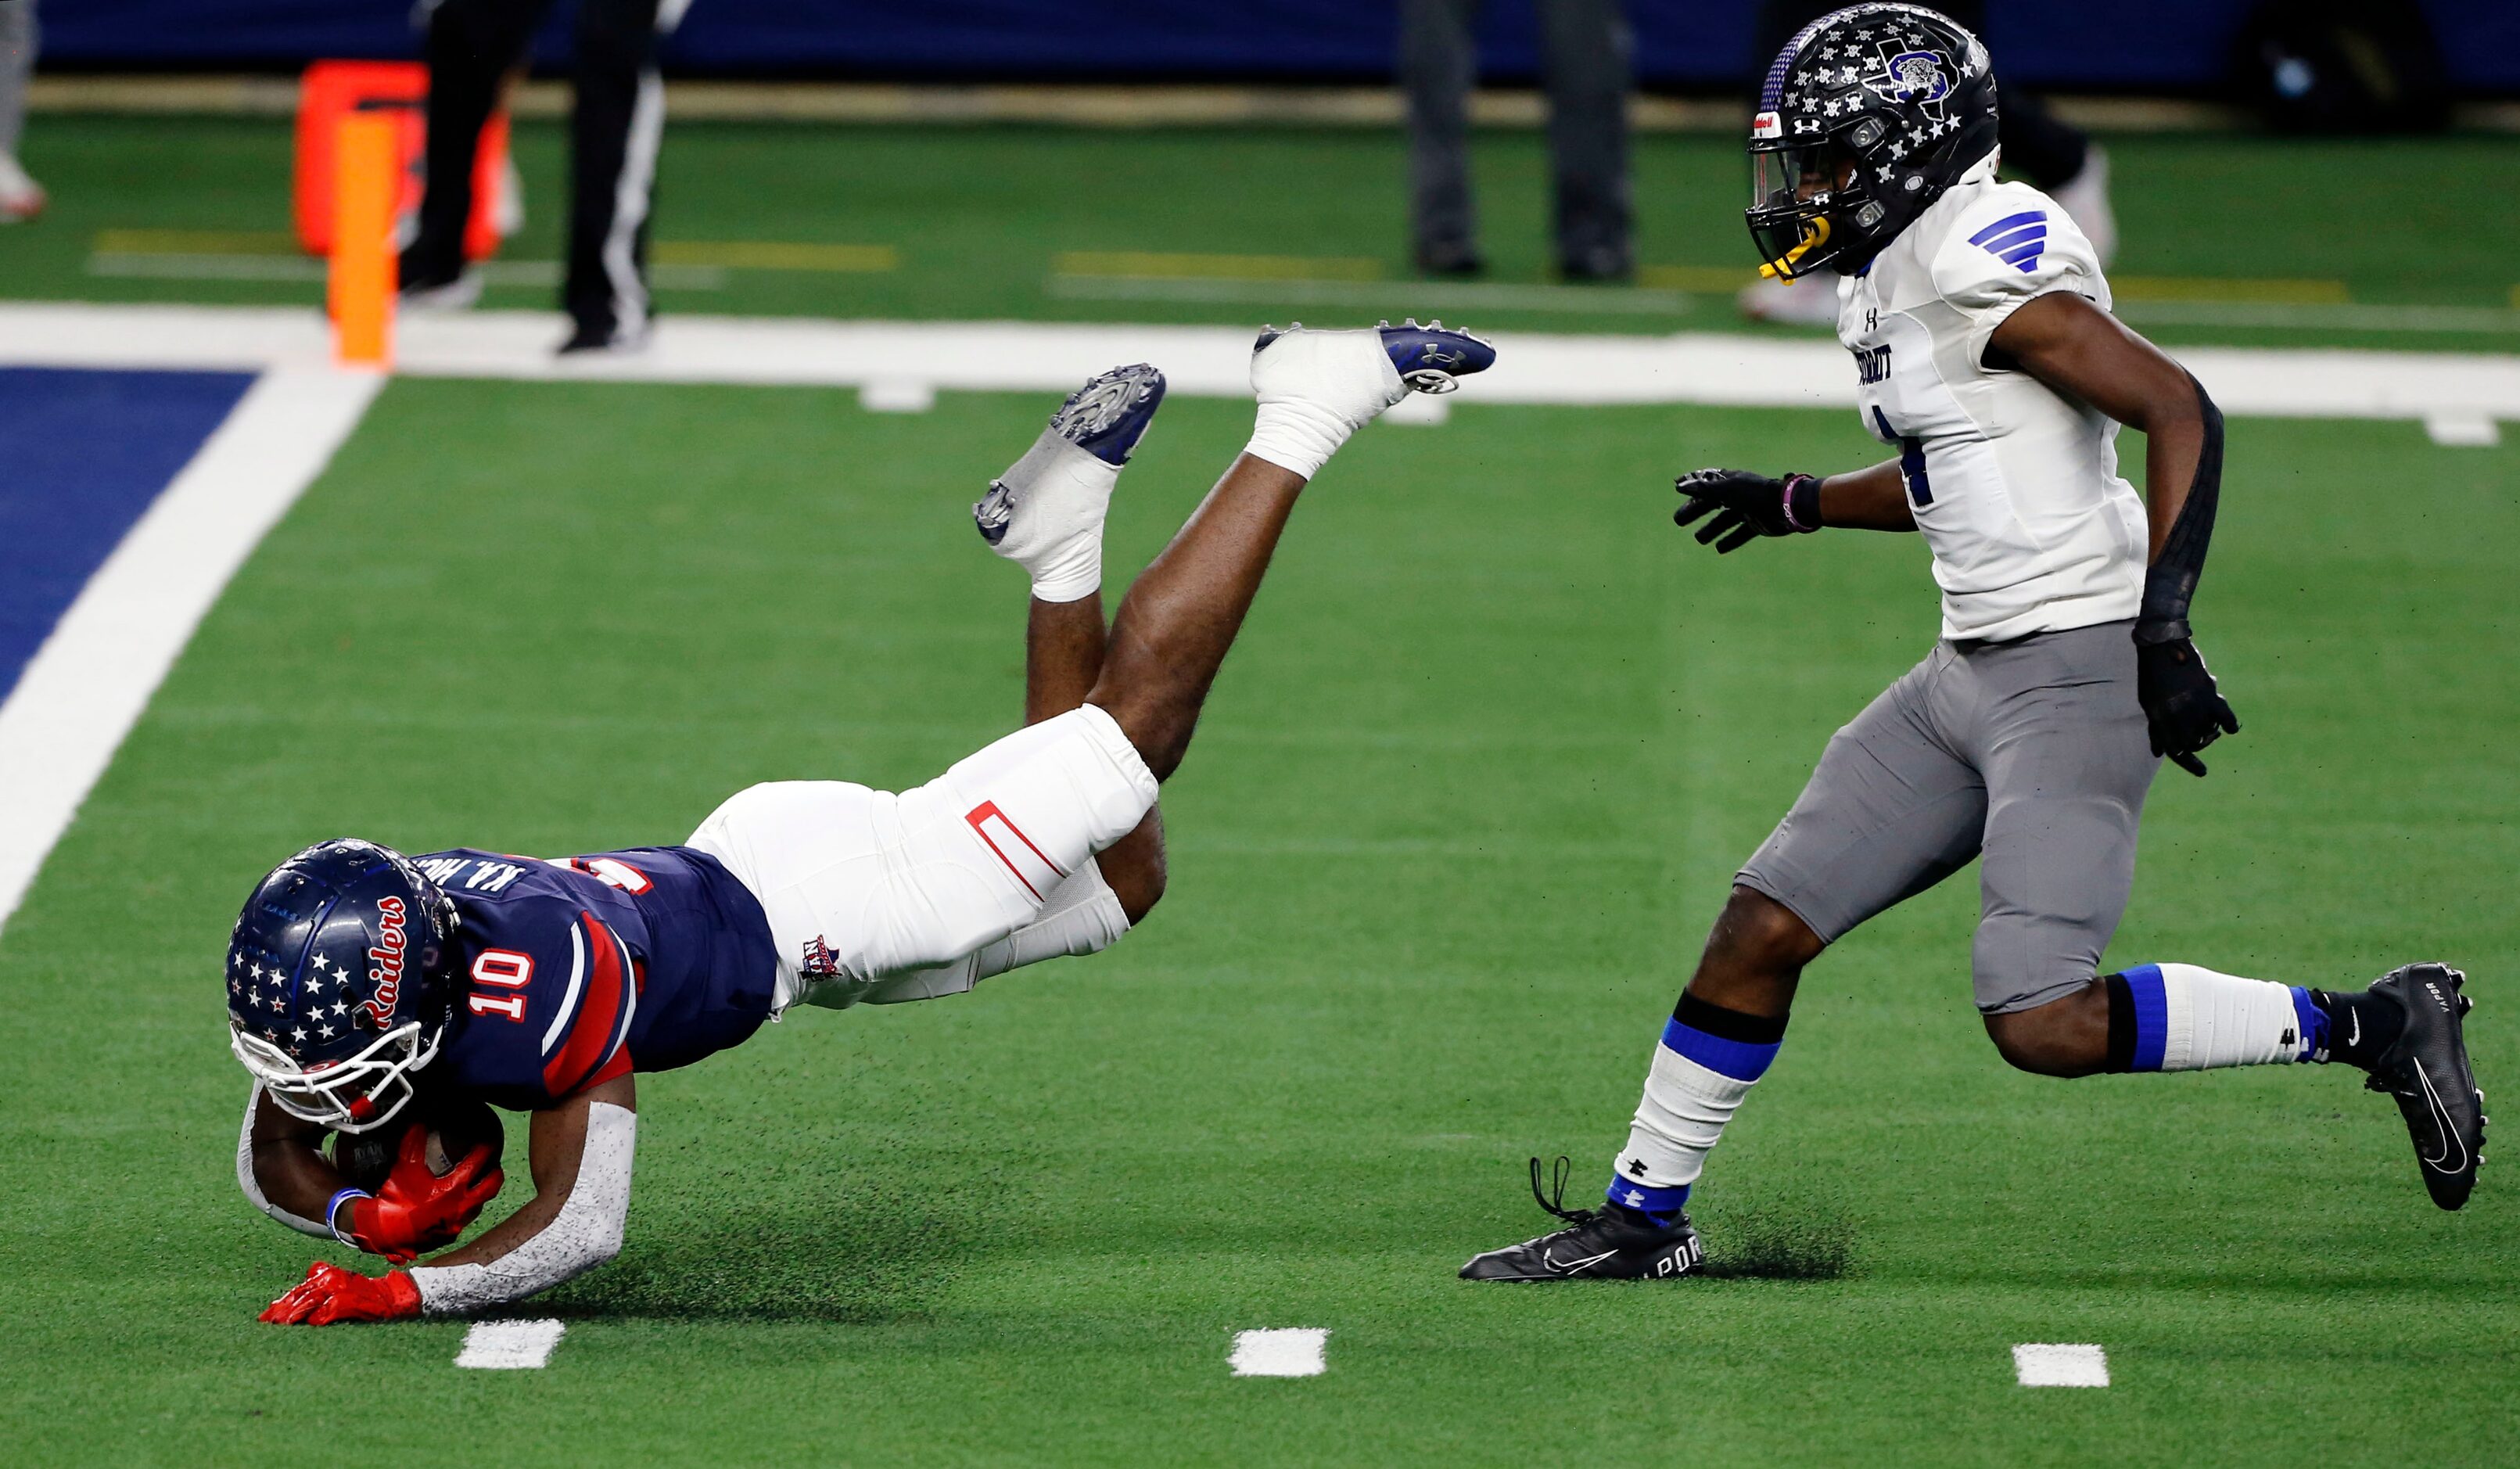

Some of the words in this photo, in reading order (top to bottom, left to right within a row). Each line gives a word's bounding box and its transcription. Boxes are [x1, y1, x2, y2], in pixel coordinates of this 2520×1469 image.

[464, 860, 526, 893] KA.
[364, 895, 407, 1031] Raiders
[468, 947, 536, 1024] 10
[2425, 982, 2451, 1014] VAPOR
[1643, 1234, 1703, 1279] POR
